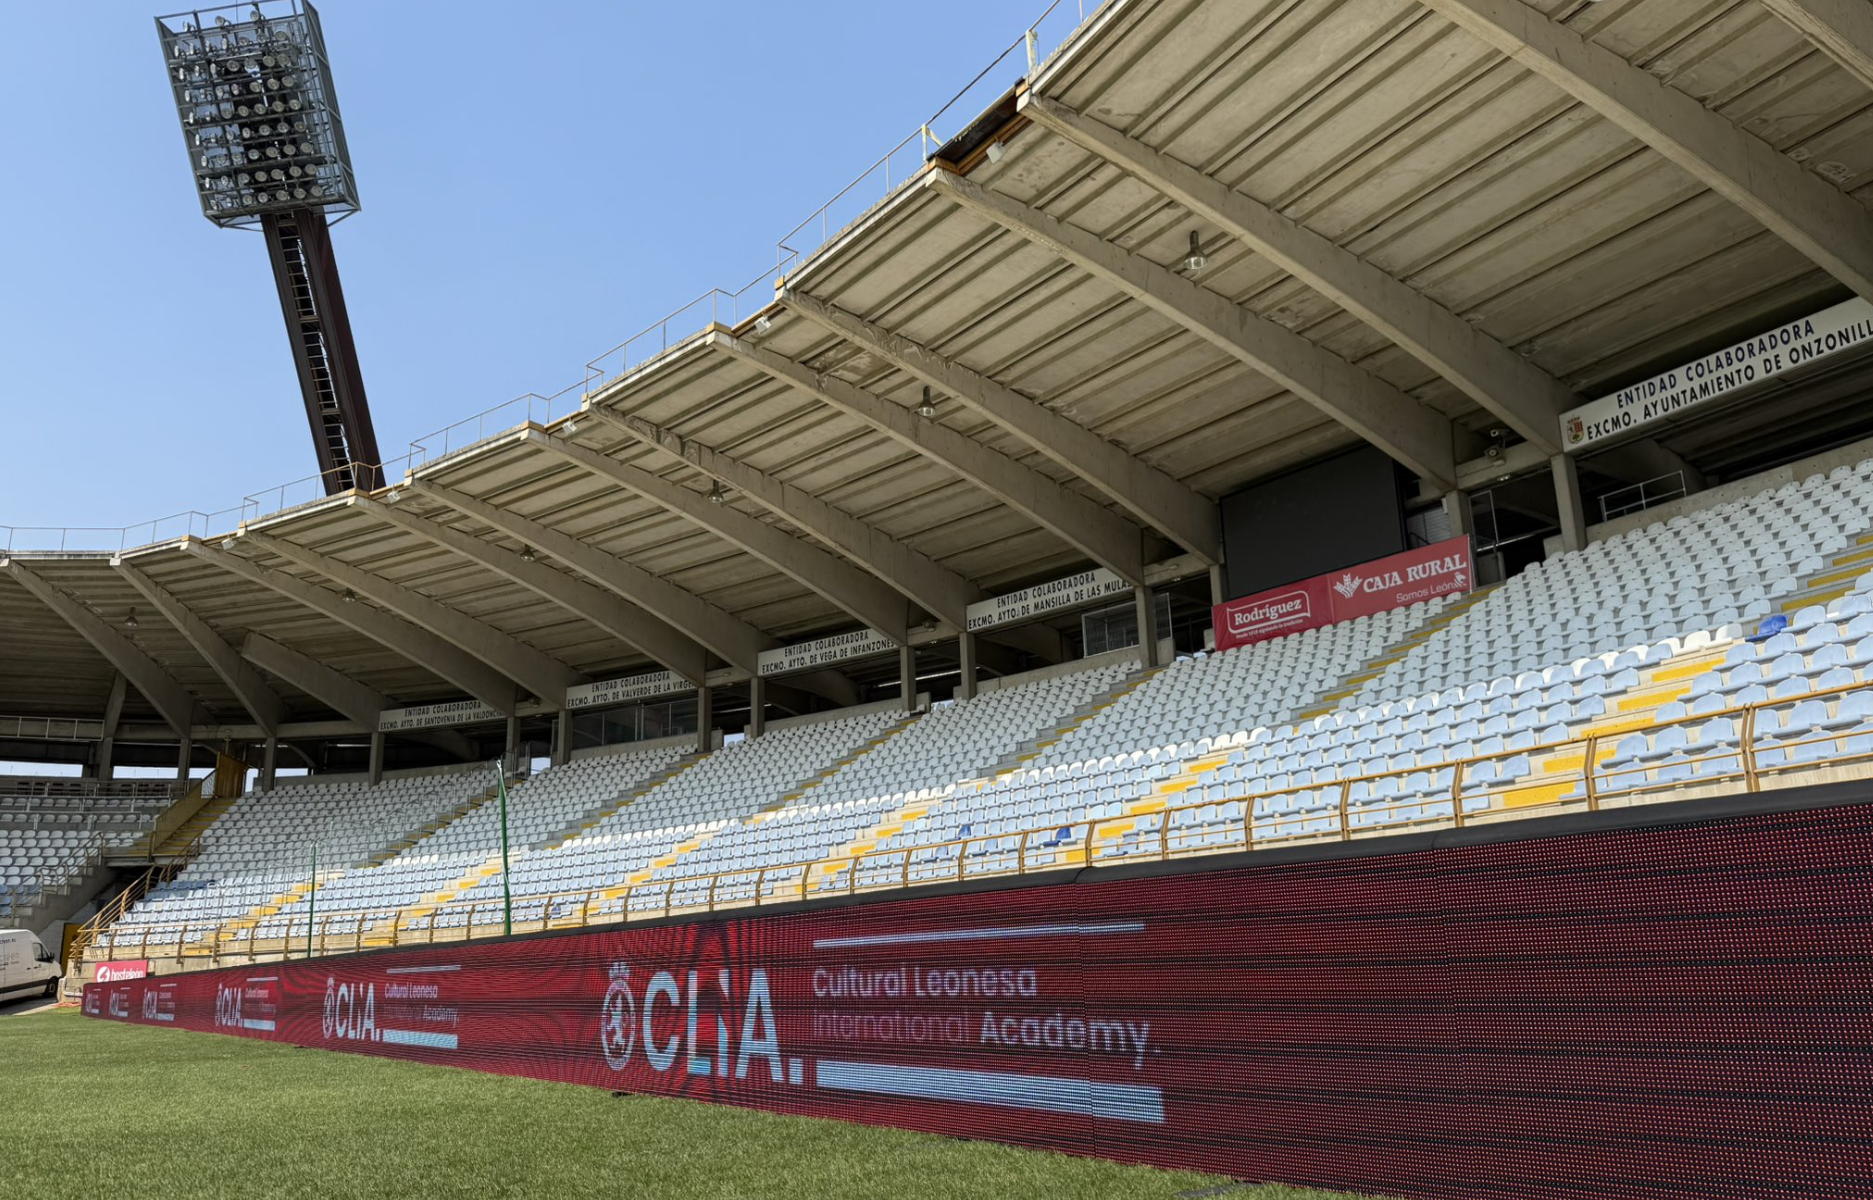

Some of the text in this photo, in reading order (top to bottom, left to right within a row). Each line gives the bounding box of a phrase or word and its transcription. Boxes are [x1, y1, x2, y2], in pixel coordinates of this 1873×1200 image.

[1617, 319, 1815, 409] ENTIDAD COLABORADORA
[1587, 412, 1637, 441] EXCMO.
[1643, 364, 1755, 421] AYUNTAMIENTO
[1764, 353, 1783, 375] DE
[1363, 554, 1467, 593] CAJA RURAL
[997, 572, 1096, 609] ENTIDAD COLABORADORA
[1396, 581, 1454, 603] Somos León
[968, 614, 996, 630] EXCMO.
[997, 609, 1019, 622] AYTO.
[1021, 606, 1030, 616] DE
[1033, 594, 1072, 613] MANSILLA
[1074, 589, 1084, 602] DE
[1087, 584, 1101, 599] LAS
[1234, 599, 1302, 626] Rodríguez
[784, 630, 869, 658] ENTIDAD COLABORADORA
[762, 661, 786, 674] EXCMO.
[788, 657, 807, 669] AYTO.
[810, 653, 818, 664] DE
[820, 650, 837, 662] VEGA
[840, 648, 848, 658] DE
[567, 696, 590, 708] EXCMO.
[592, 693, 610, 704] AYTO.
[612, 691, 620, 700] DE
[622, 686, 651, 698] VALVERDE
[654, 684, 661, 694] DE
[663, 682, 671, 692] LA
[592, 671, 670, 693] ENTIDAD COLABORADORA
[405, 701, 481, 717] ENTIDAD COLABORADORA
[409, 983, 438, 999] Leonesa
[812, 964, 1037, 997] Cultural Leonesa
[813, 1010, 969, 1044] International
